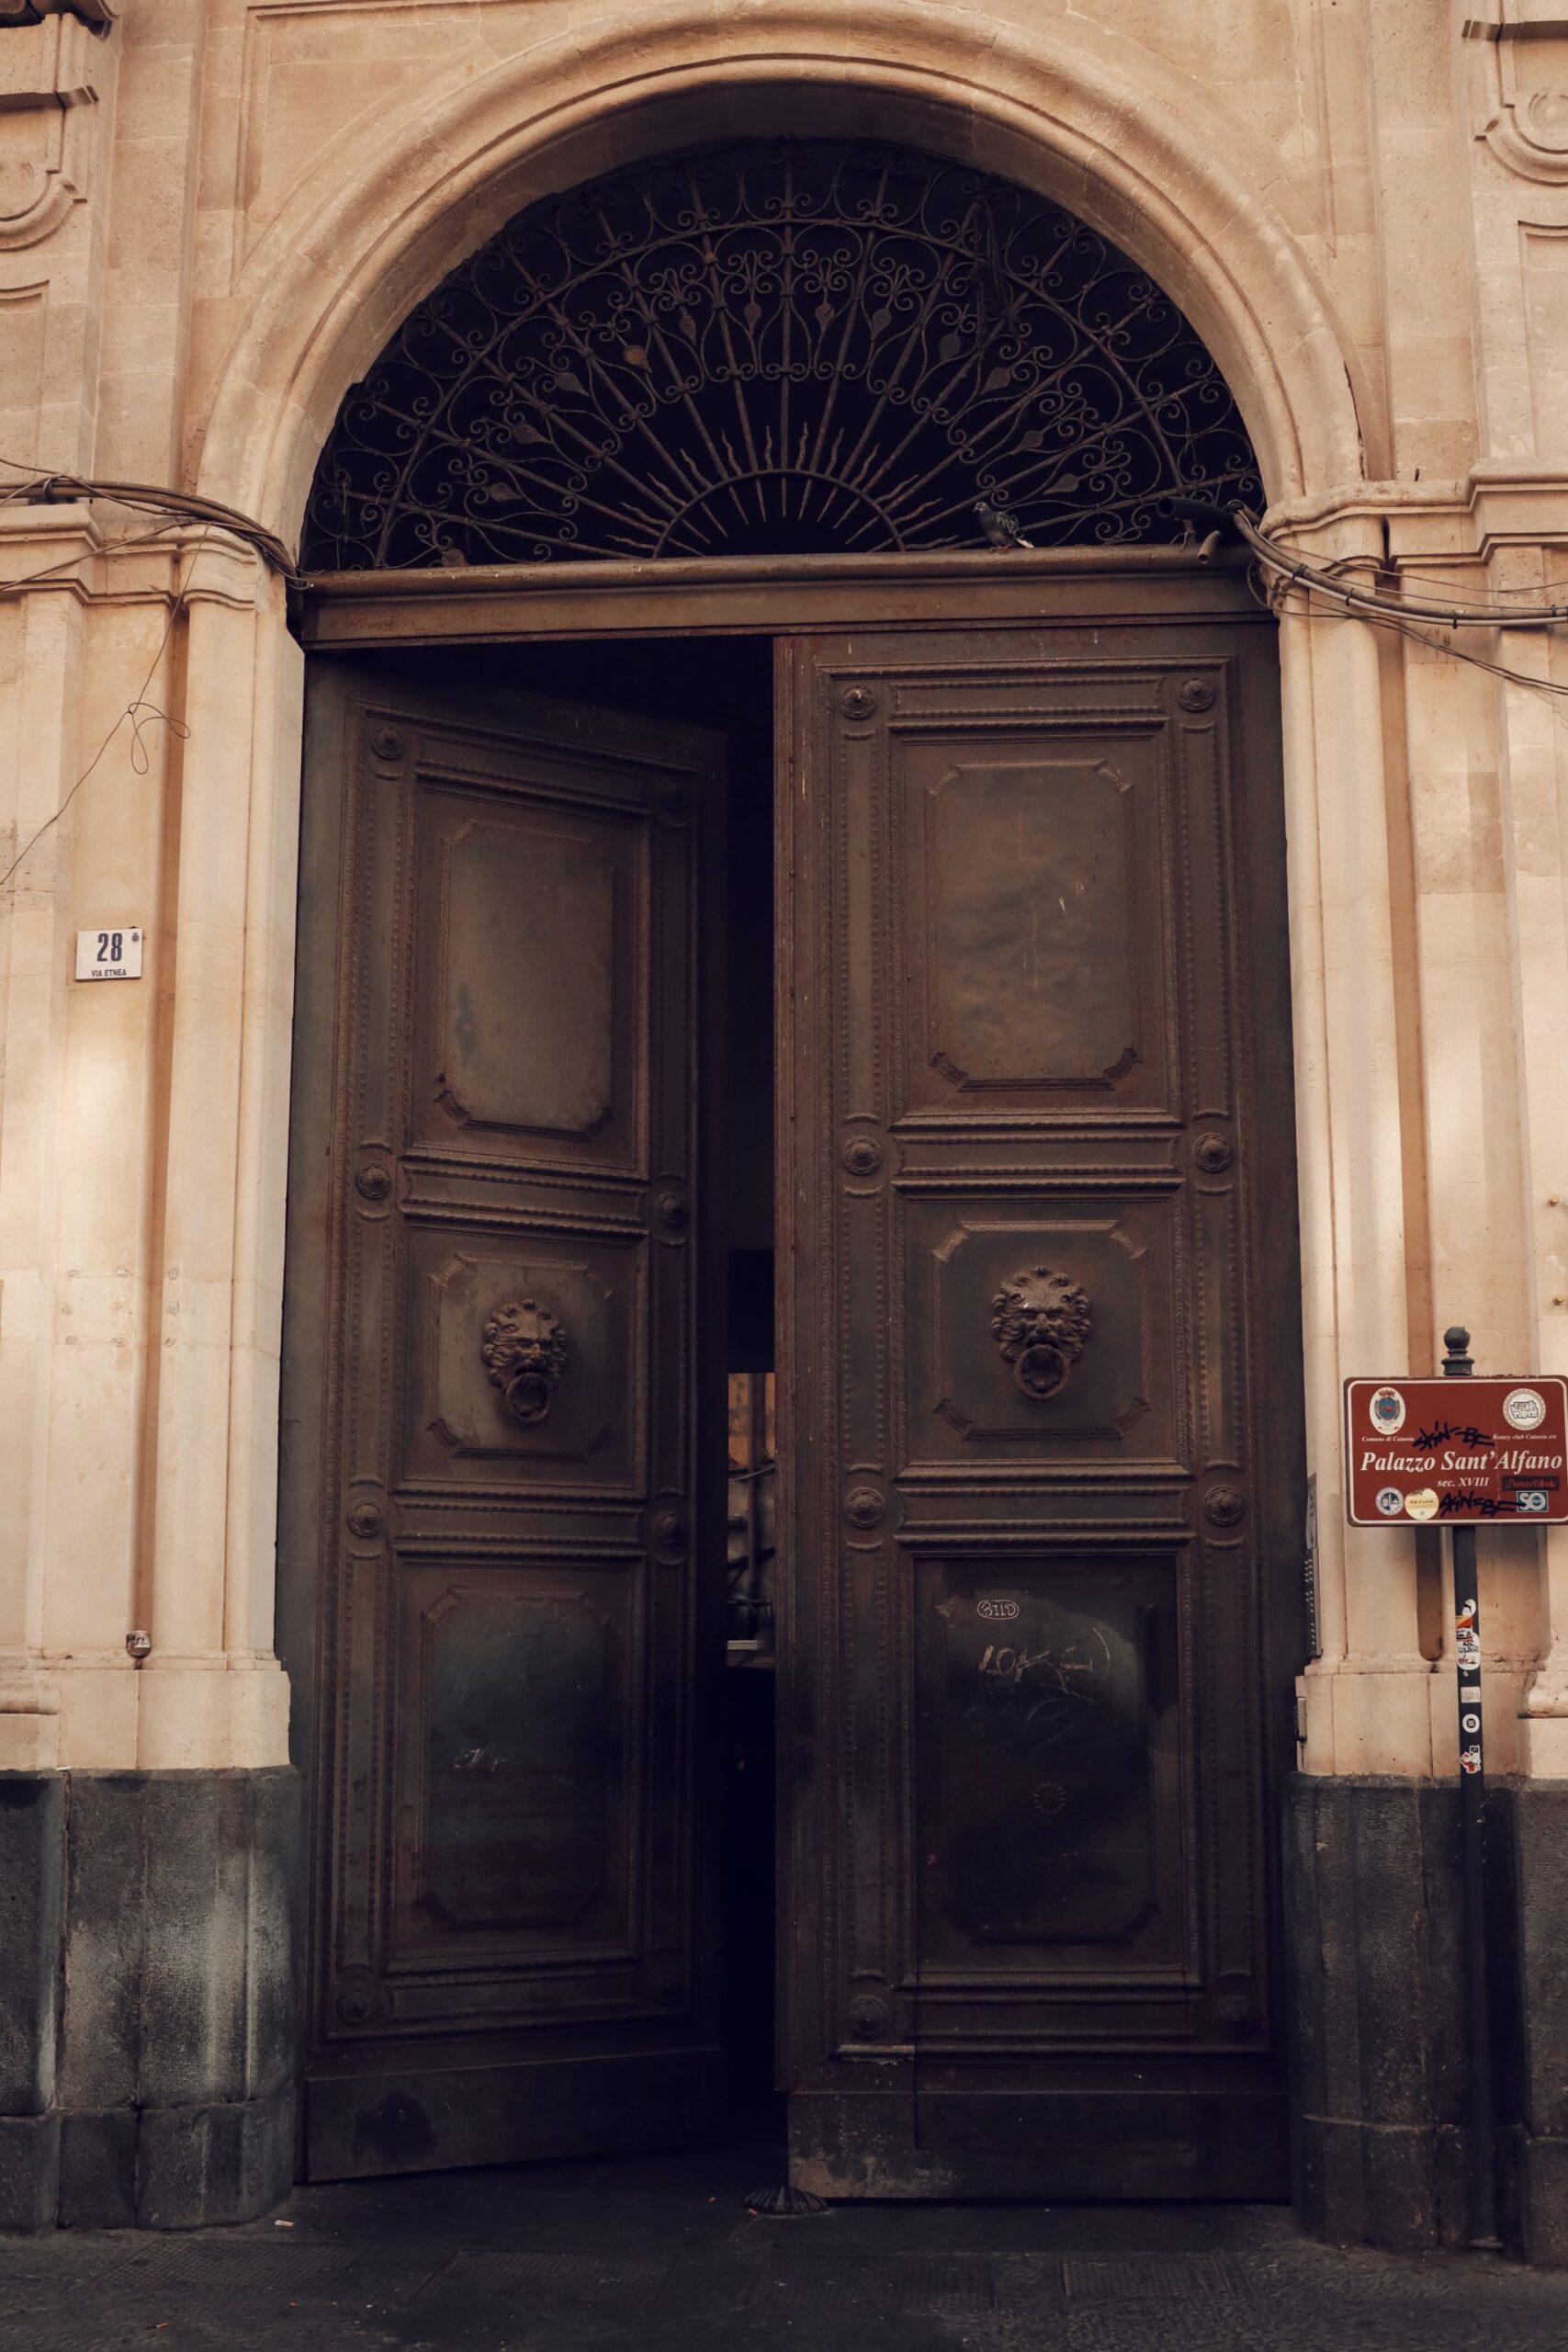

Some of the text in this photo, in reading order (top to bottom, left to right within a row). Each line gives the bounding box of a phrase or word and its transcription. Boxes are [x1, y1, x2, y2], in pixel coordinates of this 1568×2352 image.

[96, 933, 123, 962] 28
[1359, 1452, 1436, 1473] Palazzo
[1458, 1477, 1489, 1487] XVIII
